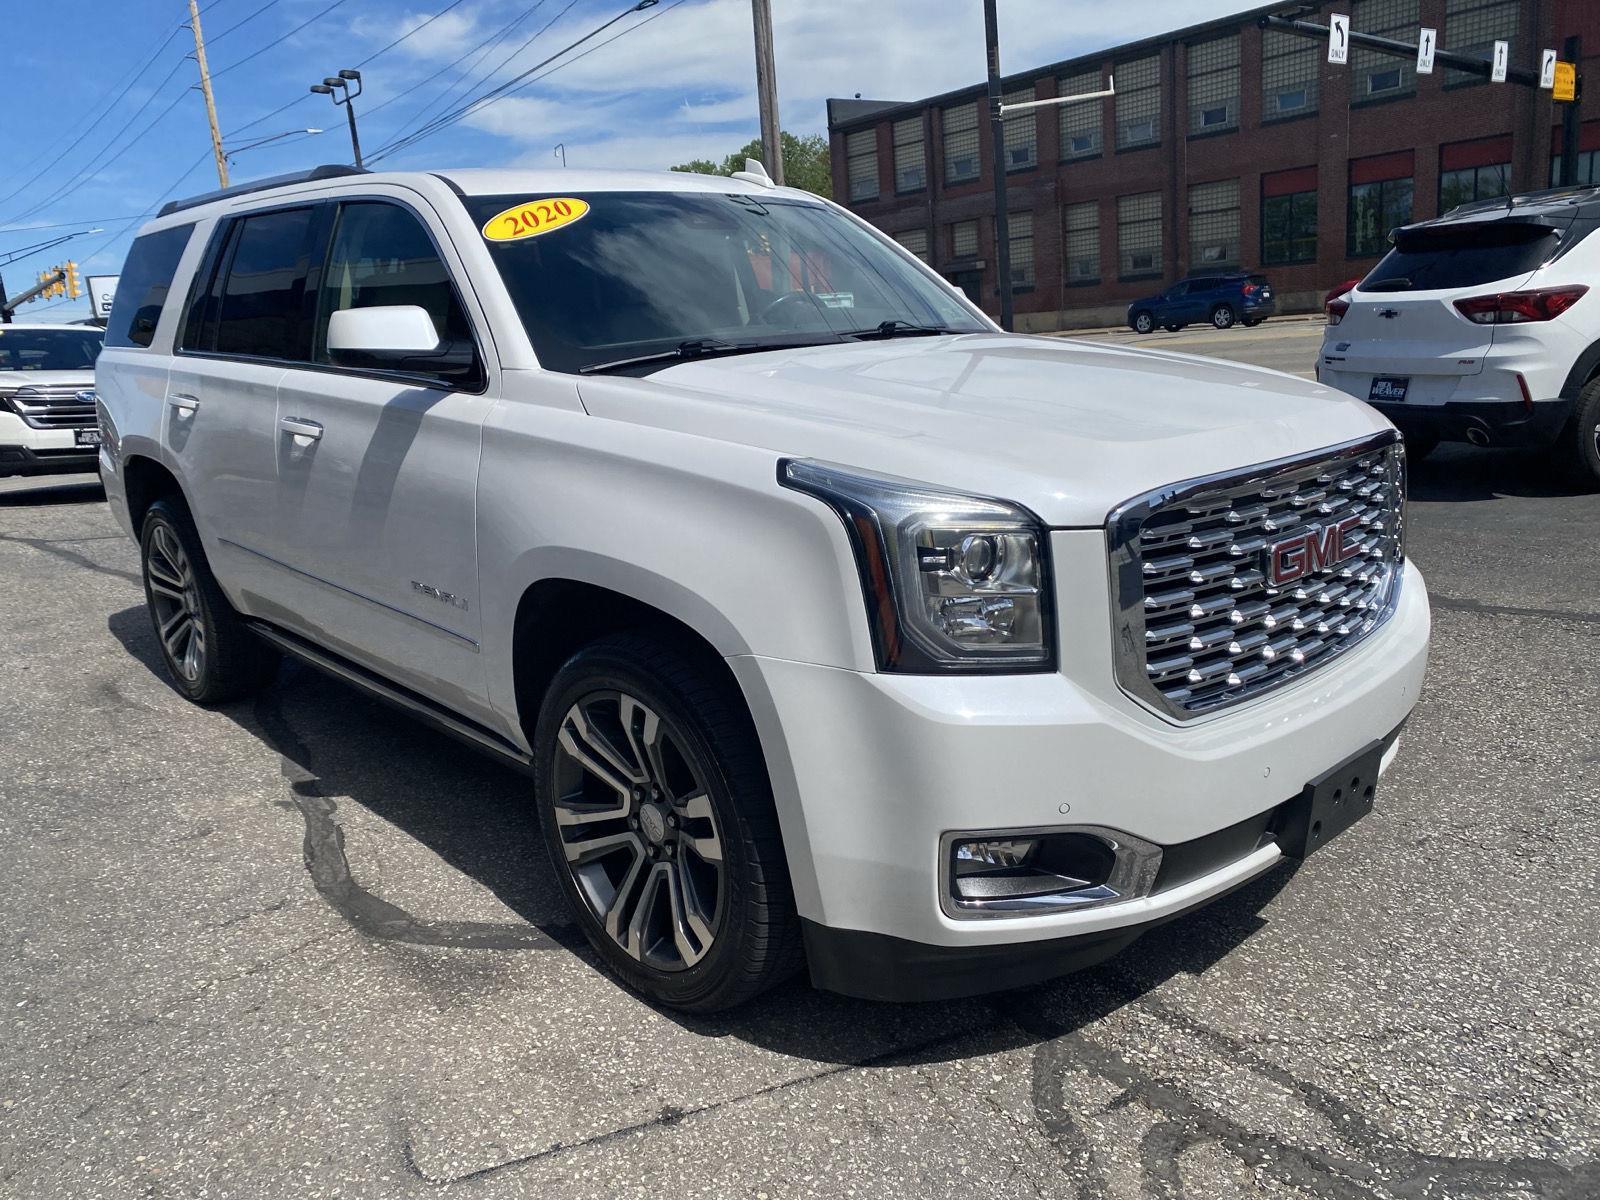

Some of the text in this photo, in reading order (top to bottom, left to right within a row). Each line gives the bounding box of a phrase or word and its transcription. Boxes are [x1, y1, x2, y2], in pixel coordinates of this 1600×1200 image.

[1330, 49, 1345, 58] ONLY
[504, 200, 572, 236] 2020
[1372, 386, 1405, 395] WEAVER
[1269, 514, 1361, 586] GMC
